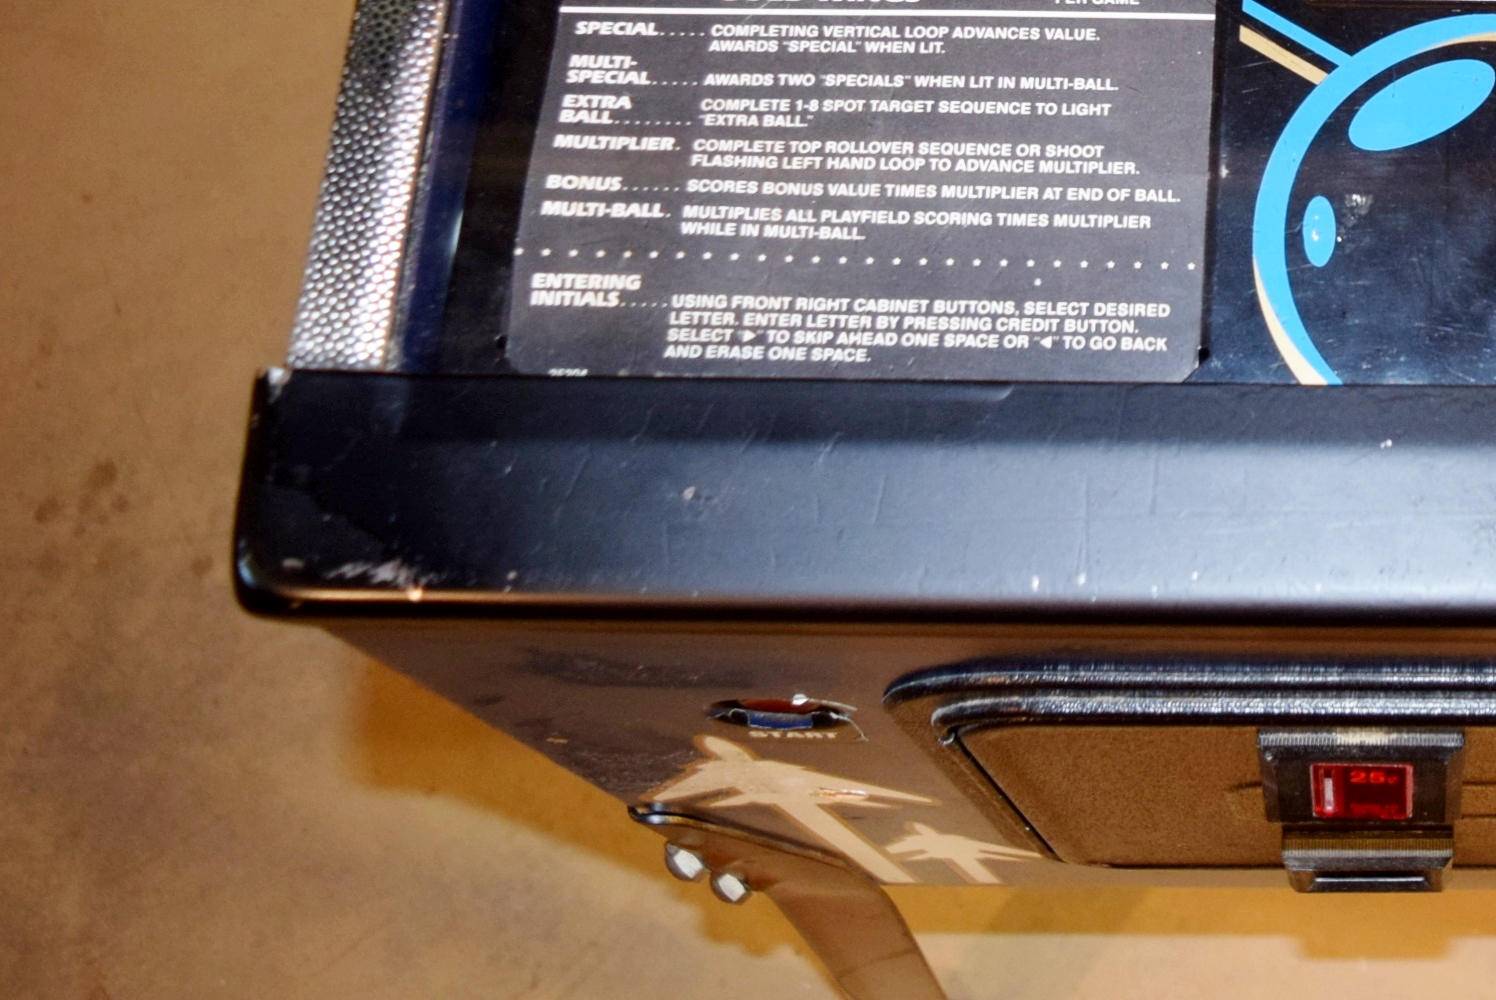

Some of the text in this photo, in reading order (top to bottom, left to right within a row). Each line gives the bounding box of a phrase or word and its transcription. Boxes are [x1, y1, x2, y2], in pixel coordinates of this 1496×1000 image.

[710, 25, 1100, 41] COMPLETING VERTICAL LOOP ADVANCES VALUE.
[708, 40, 778, 52] AWARDS
[865, 41, 915, 53] WHEN
[919, 42, 945, 53] LIT.
[568, 55, 637, 70] MULTI-
[703, 73, 774, 86] AWARDS
[778, 73, 815, 86] TWO
[914, 75, 965, 88] WHEN
[969, 76, 994, 88] LIT
[998, 77, 1015, 89] IN
[561, 95, 1112, 116] EXTRA COMPLETE 1-8 SPOT TARGET SEQUENCE TO LIGHT
[693, 140, 785, 153] COMPLETE
[789, 141, 822, 153] TOP
[825, 141, 914, 154] ROLLOVER
[918, 143, 1012, 156] SEQUENCE
[1016, 144, 1041, 157] OR
[1045, 145, 1104, 158] SHOOT
[691, 154, 778, 168] FLASHING
[783, 157, 823, 169] LEFT
[827, 157, 876, 169] HAND
[880, 157, 925, 170] LOOP
[929, 158, 951, 171] TO
[956, 159, 1034, 172] ADVANCE
[686, 179, 1180, 202] SCORES BONUS VALUE TIMES MULTIPLIER AT END OF BALL.
[682, 208, 781, 224] MULTIPLIES
[786, 210, 816, 222] ALL
[821, 210, 910, 224] PLAYFIELD
[913, 211, 992, 227] SCORING
[997, 213, 1049, 227] TIMES
[1053, 214, 1151, 228] MULTIPLIER
[680, 222, 737, 236] WHILE
[740, 224, 760, 237] IN
[531, 274, 641, 291] ENTERING
[671, 294, 1170, 317] USING FRONT RIGHT CABINET BUTTONS, SELECT DESIRED
[669, 312, 1138, 333] LETTER. ENTER LETTER BY PRESSING CREDIT BUTTON.
[666, 328, 1167, 351] SELECT TO SKIP AHEAD ONE SPACE OR TO GO BACK
[663, 345, 871, 362] AND ERASE ONE SPACE.
